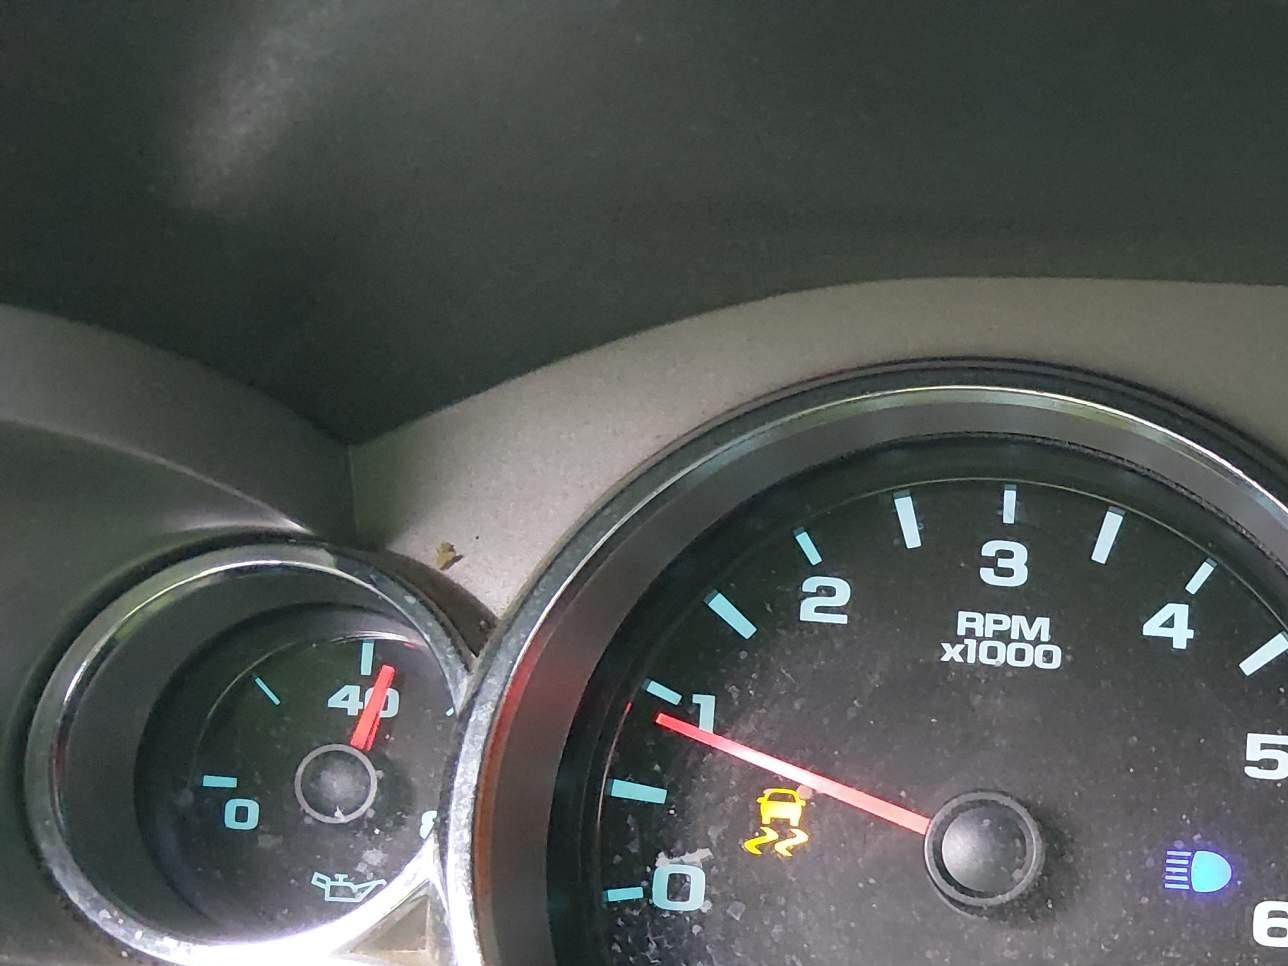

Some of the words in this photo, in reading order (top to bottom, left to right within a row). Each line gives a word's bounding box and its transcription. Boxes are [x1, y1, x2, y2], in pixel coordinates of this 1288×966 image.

[980, 540, 1029, 587] 3
[800, 576, 851, 624] 2
[956, 611, 1051, 641] RPM
[1142, 602, 1194, 649] 4
[940, 638, 1062, 670] x1000
[692, 694, 716, 734] 1
[224, 798, 260, 831] 0
[652, 863, 706, 911] 0
